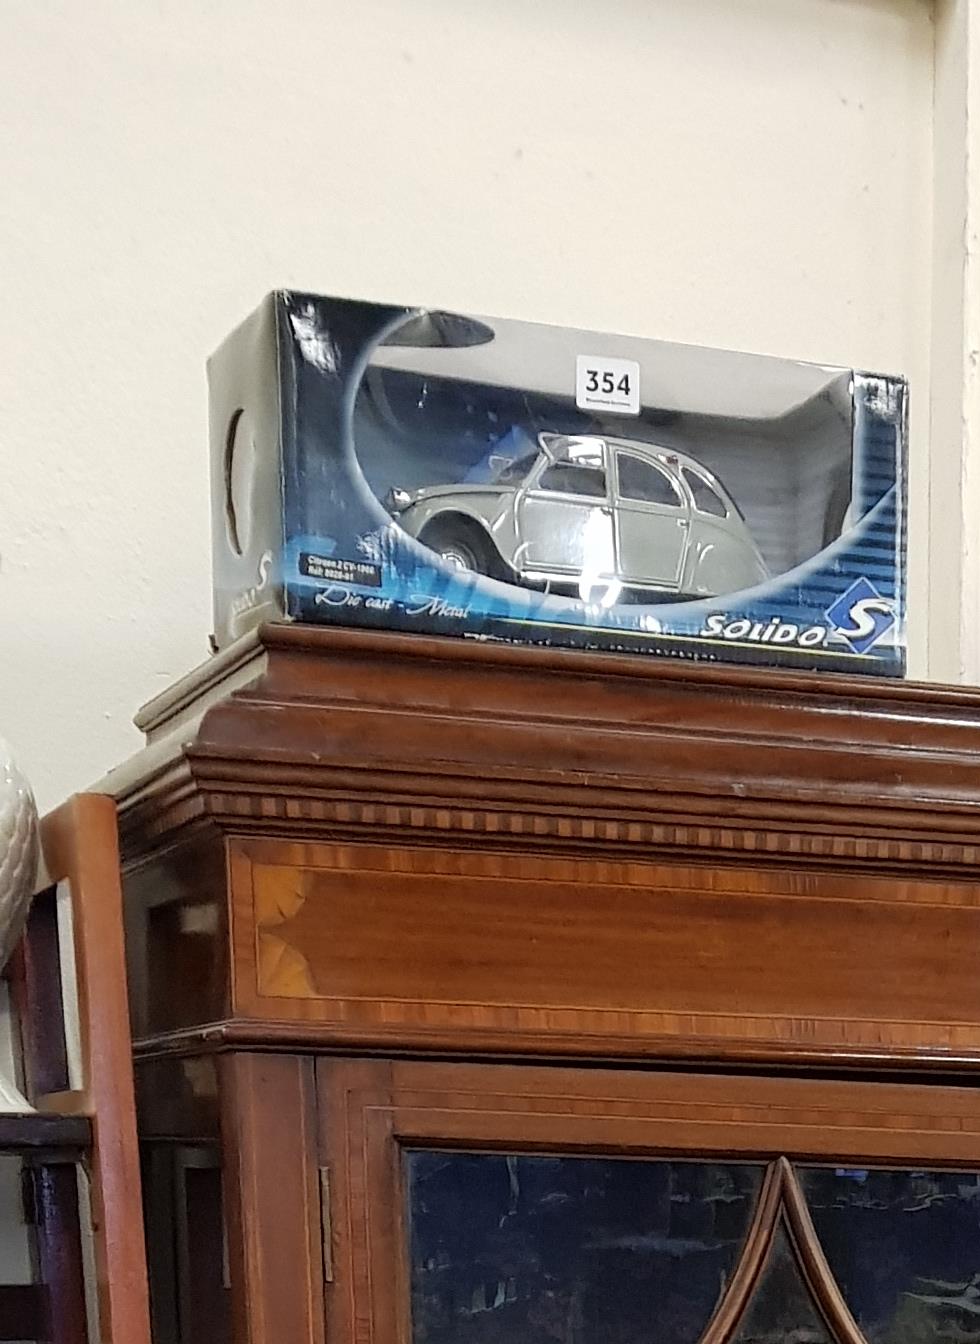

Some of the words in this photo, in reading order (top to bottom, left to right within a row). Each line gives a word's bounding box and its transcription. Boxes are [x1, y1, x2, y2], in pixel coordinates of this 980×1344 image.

[586, 369, 631, 396] 354
[315, 582, 360, 606] Die
[365, 596, 394, 610] cast
[406, 593, 469, 618] Metal
